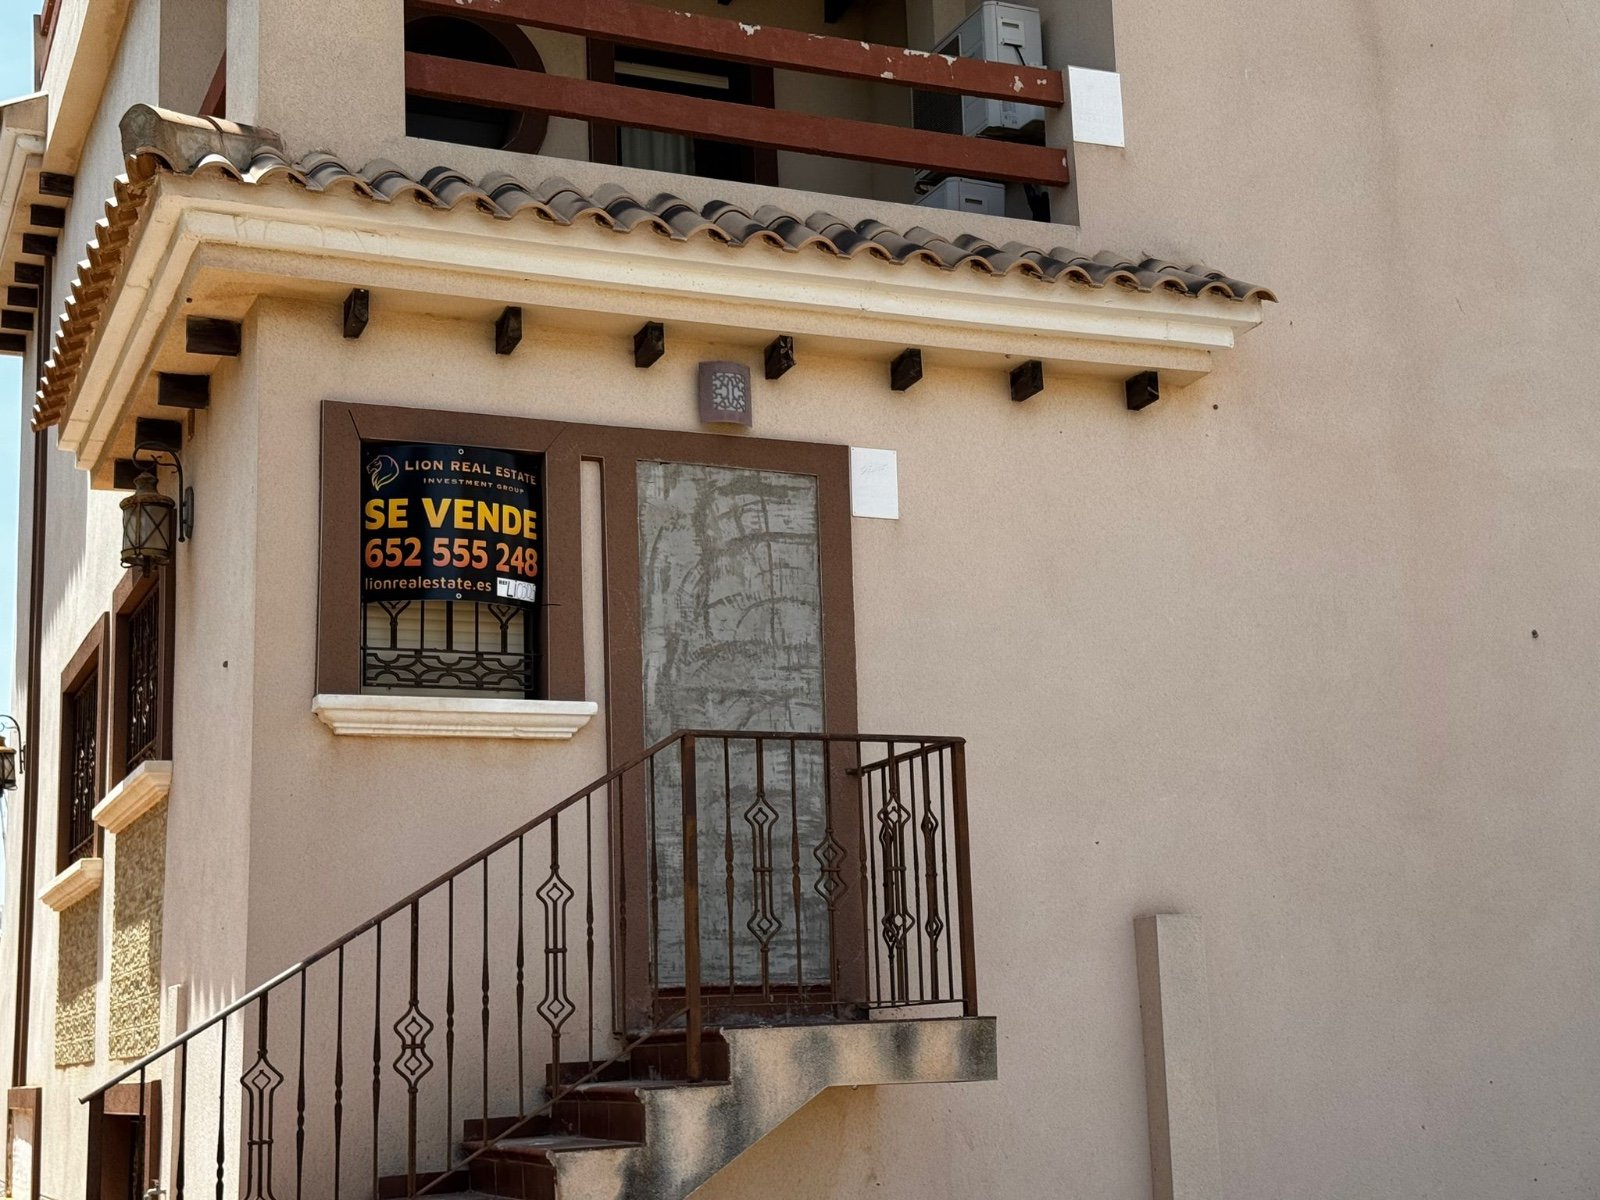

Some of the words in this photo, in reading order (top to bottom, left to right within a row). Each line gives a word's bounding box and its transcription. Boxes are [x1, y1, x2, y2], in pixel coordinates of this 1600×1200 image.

[405, 460, 444, 471] LION
[450, 461, 491, 475] REAL
[495, 466, 537, 485] ESTATE
[423, 478, 493, 488] INVESTMENT
[496, 484, 525, 494] GROUP
[364, 498, 409, 530] SE
[421, 498, 538, 540] VENDE
[364, 537, 422, 568] 652
[432, 537, 489, 570] 555
[495, 542, 538, 577] 248
[365, 576, 492, 592] lionrealestate.es
